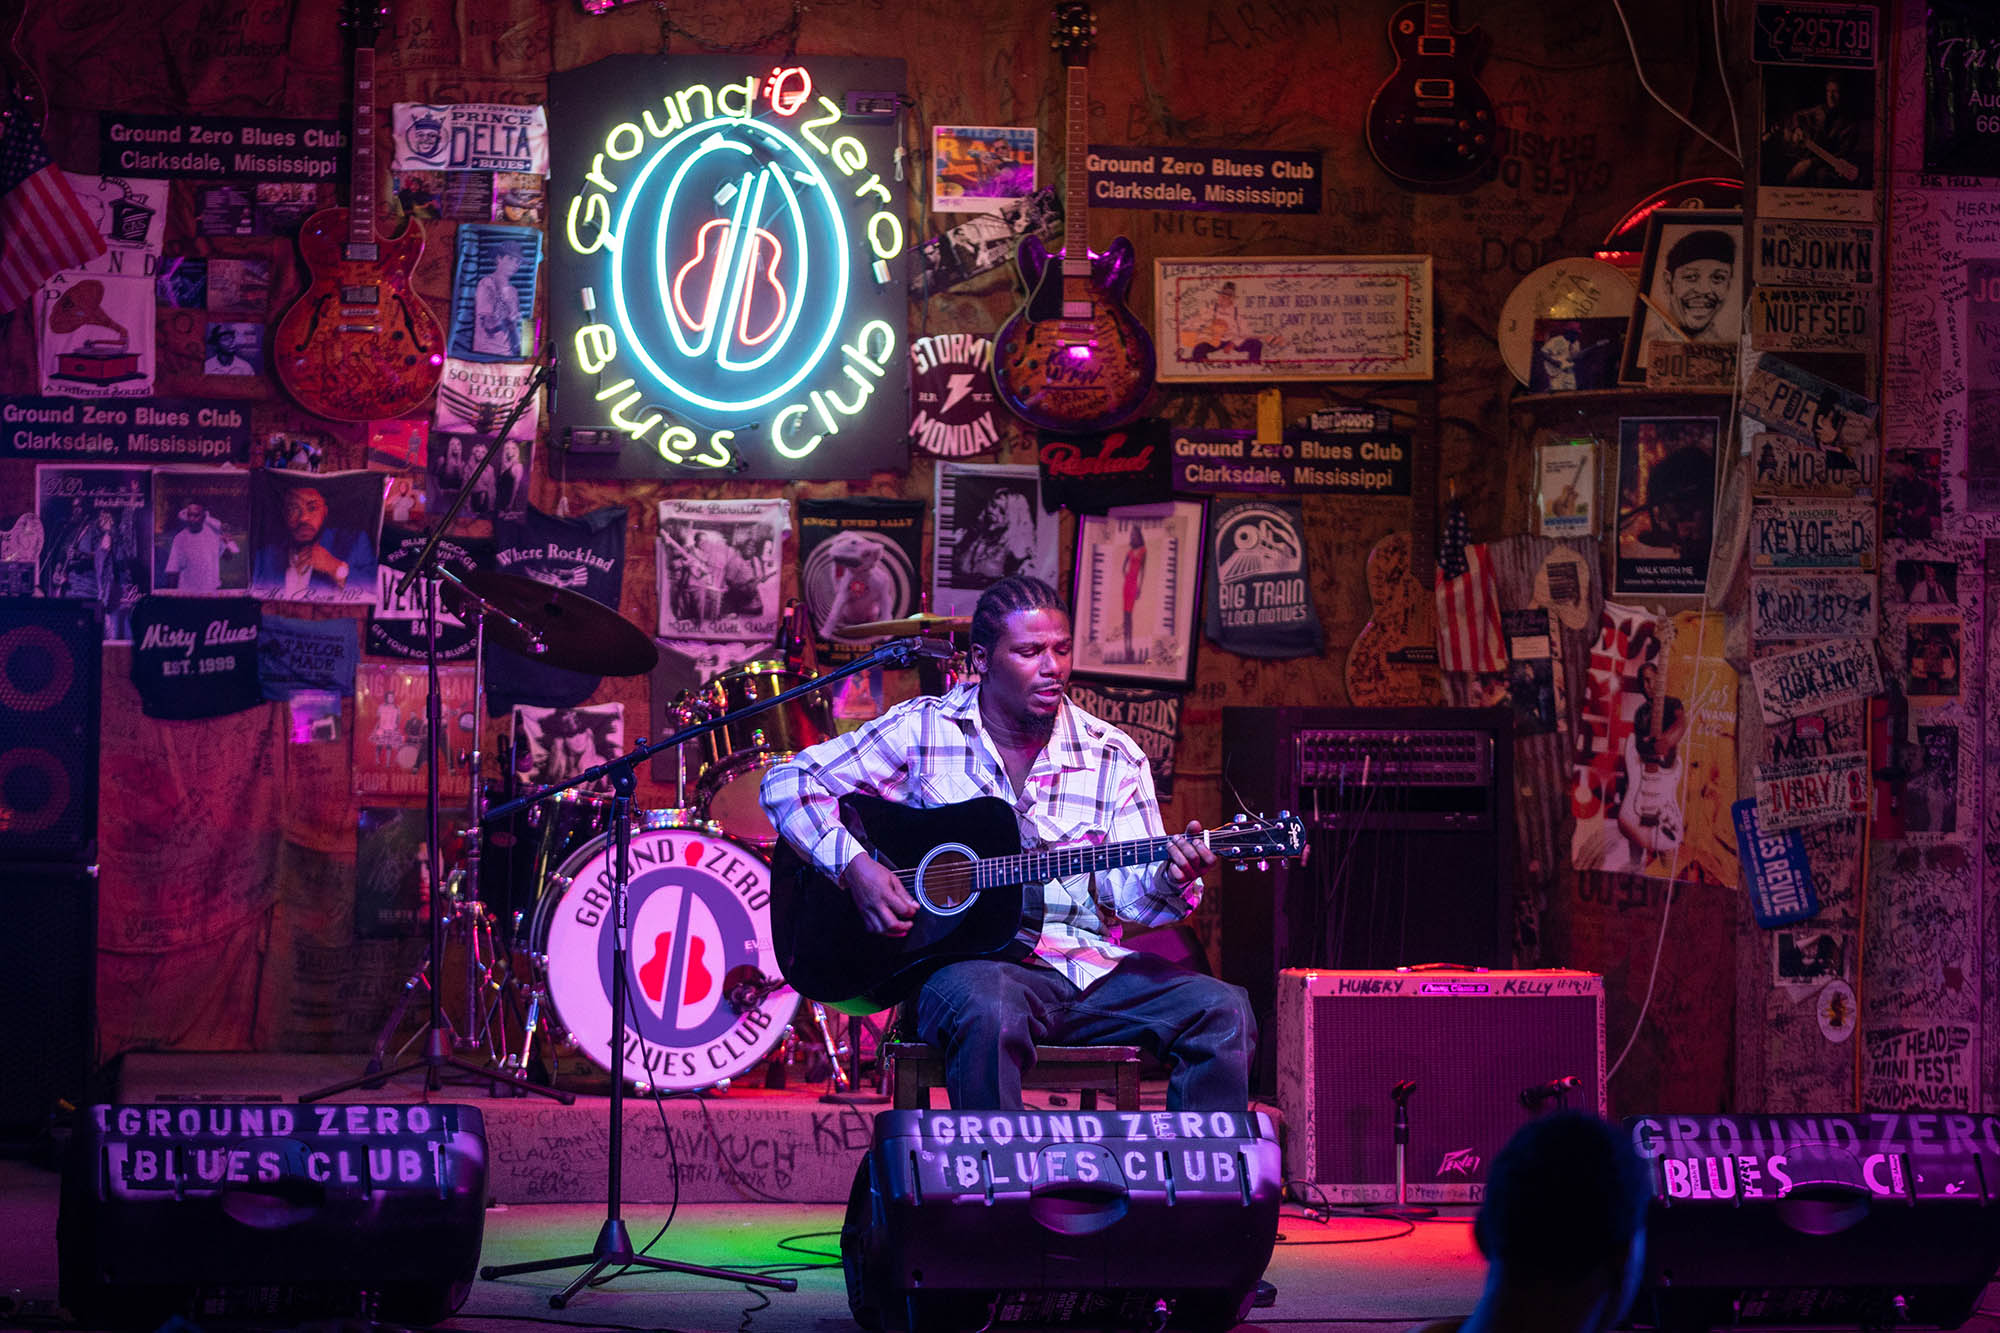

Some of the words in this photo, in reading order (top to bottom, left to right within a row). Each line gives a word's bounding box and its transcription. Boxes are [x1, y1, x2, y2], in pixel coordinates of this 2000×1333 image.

[452, 112, 533, 126] PRINCE
[110, 123, 181, 146] Ground
[189, 125, 234, 146] Zero
[241, 127, 296, 148] Blues
[304, 129, 347, 149] Club
[450, 125, 531, 167] DELTA
[120, 151, 225, 173] Clarksdale,
[234, 153, 337, 176] Mississippi
[479, 159, 524, 169] BLUES
[566, 76, 756, 255] Ground
[800, 96, 903, 259] Zero
[1085, 153, 1155, 174] Ground
[1161, 156, 1205, 176] Zero
[1211, 158, 1264, 178] Blues
[1271, 161, 1315, 180] Club
[1095, 180, 1197, 204] Clarksdale,
[1204, 184, 1304, 208] Mississippi
[469, 385, 515, 401] HALO
[574, 323, 735, 468] Blues
[771, 319, 896, 459] Club
[3, 404, 74, 425] Ground
[82, 405, 127, 425] Zero
[135, 407, 190, 427] Blues
[198, 408, 242, 428] Club
[13, 431, 120, 455] Clarksdale,
[128, 433, 232, 457] Mississippi
[908, 409, 1000, 456] MONDAY
[1175, 438, 1244, 457] Ground
[1251, 440, 1294, 459] Zero
[1300, 441, 1353, 460] Blues
[1360, 442, 1403, 462] Club
[1184, 463, 1286, 487] Clarksdale,
[1293, 467, 1393, 490] Mississippi
[496, 546, 543, 566] Where
[547, 543, 615, 573] Rockland
[1219, 583, 1246, 610] BIG
[1253, 577, 1306, 607] TRAIN
[140, 624, 198, 658] Misty
[204, 620, 258, 648] Blues
[411, 621, 443, 638] BAD
[1789, 644, 1837, 668] TEXAS
[705, 845, 772, 912] ZERO
[1763, 858, 1801, 918] REVUE
[1339, 979, 1404, 995] HUNGRY
[1503, 980, 1553, 997] KELLY
[706, 1006, 772, 1070] CLUB
[1906, 1026, 1947, 1056] HEAD
[1873, 1059, 1909, 1080] MINI
[118, 1107, 295, 1137] GROUND
[315, 1106, 432, 1137] ZERO
[931, 1115, 1103, 1147] GROUND
[1120, 1111, 1237, 1141] ZERO
[1632, 1116, 1862, 1160] GROUND
[1870, 1114, 2000, 1157] ZERO
[134, 1148, 281, 1184] BLUES
[307, 1149, 424, 1184] CLUB
[956, 1150, 1100, 1189] BLUES
[1125, 1150, 1236, 1184] CLUB
[1664, 1154, 1794, 1200] BLUES
